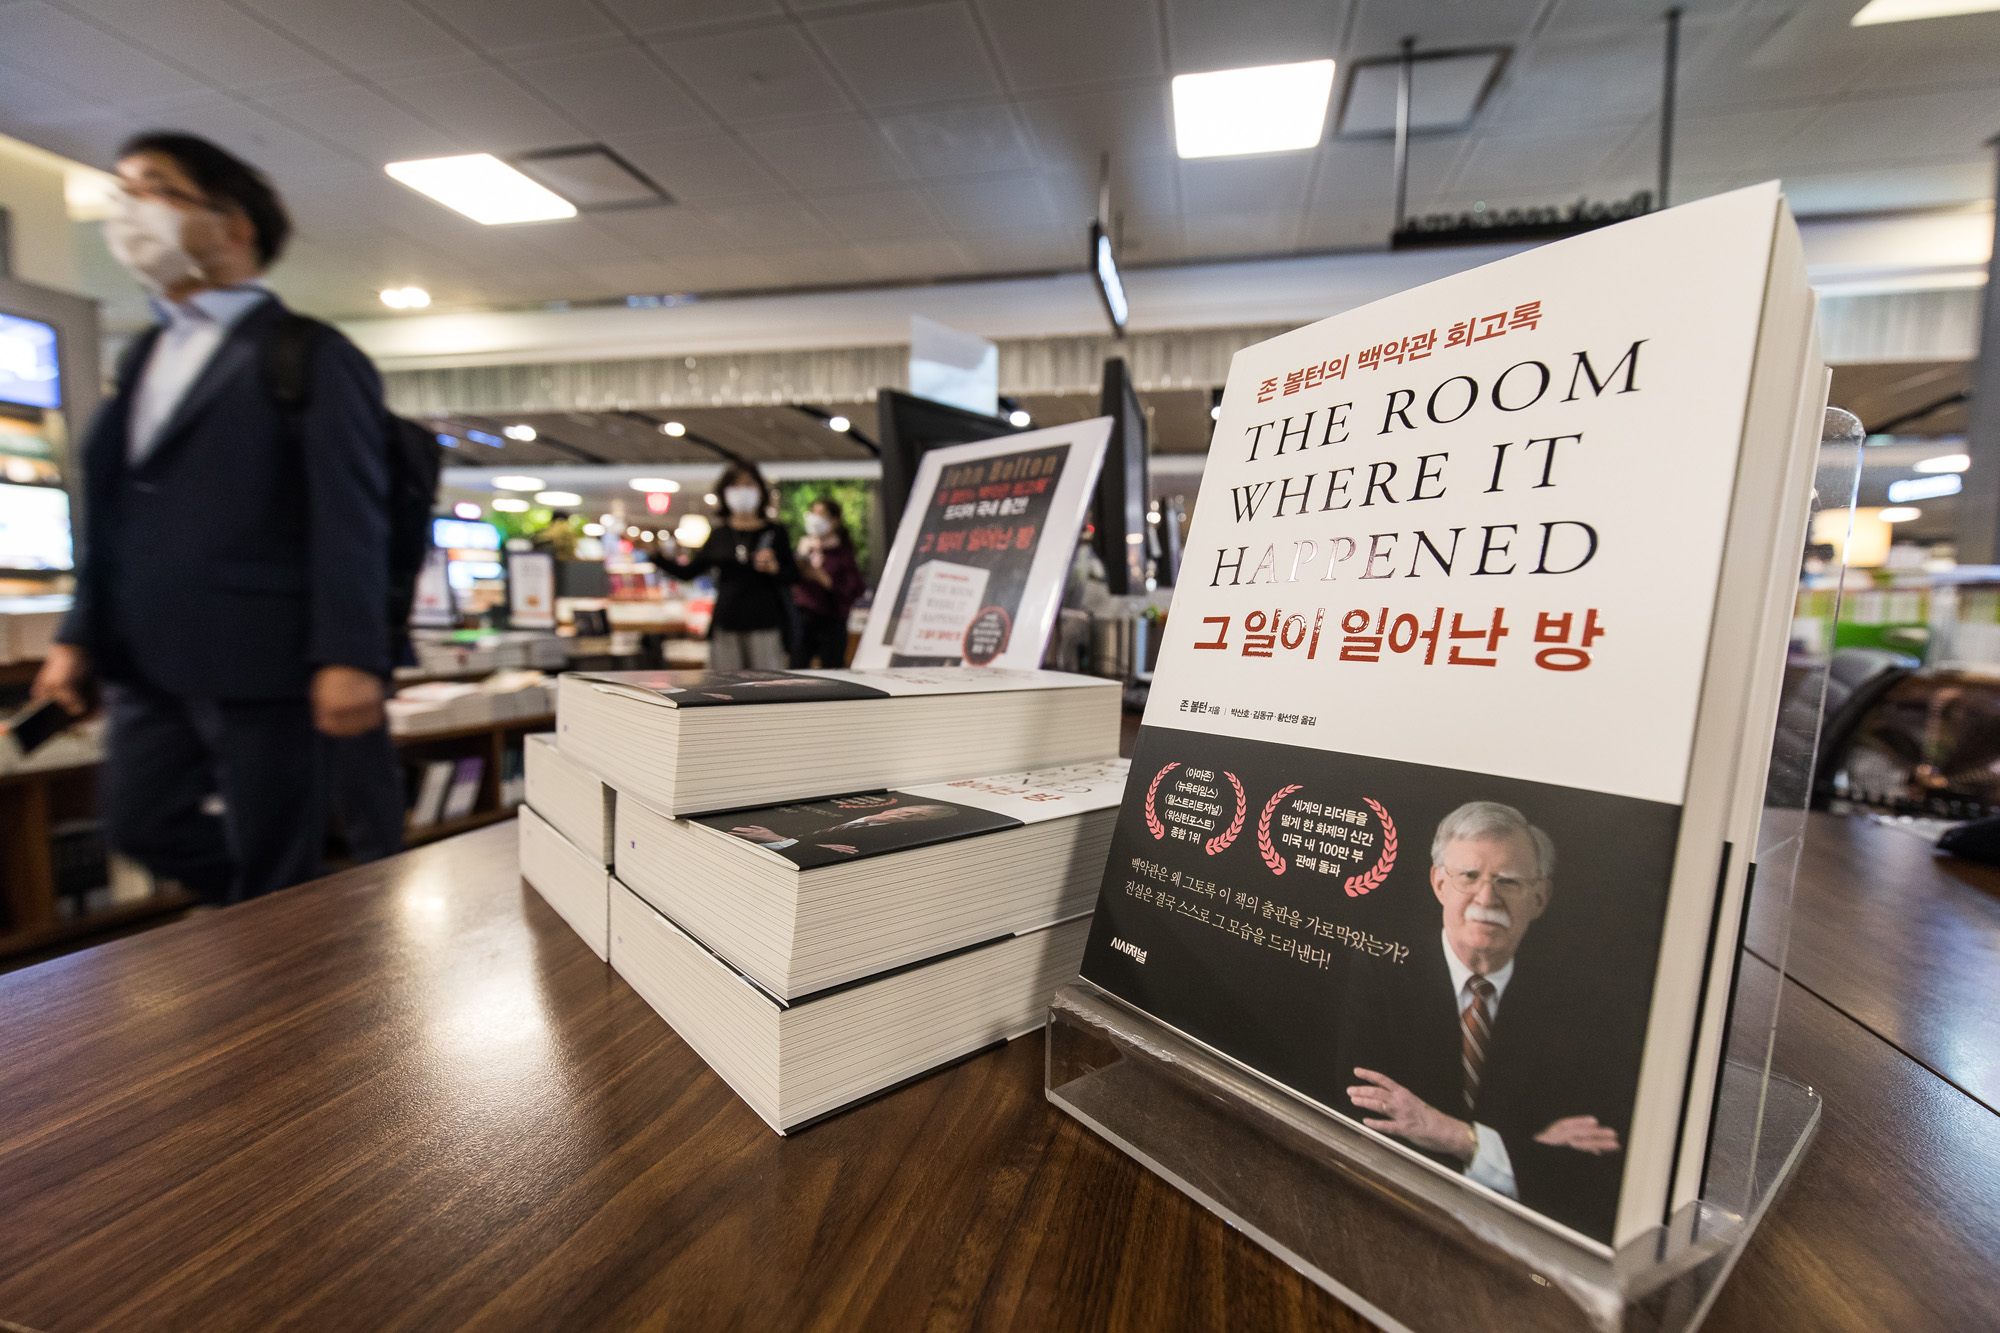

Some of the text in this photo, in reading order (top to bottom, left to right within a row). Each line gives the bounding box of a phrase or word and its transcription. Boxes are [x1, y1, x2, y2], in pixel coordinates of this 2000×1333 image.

[1257, 300, 1543, 403] 존 볼턴의 백악관 회고록
[1244, 338, 1652, 462] THE ROOM
[1231, 432, 1584, 524] WHERE IT
[1209, 520, 1600, 588] HAPPENED
[1193, 606, 1607, 672] 그 일이 일어난 방
[1180, 699, 1189, 712] 존
[1190, 700, 1208, 714] 볼턴
[1208, 706, 1221, 715] 지음
[1300, 715, 1317, 726] 옮김
[1170, 826, 1201, 844] 종합 1위
[1281, 814, 1374, 847] 떨게 한 화제의 신간
[1292, 800, 1368, 827] 세계의 리더들을
[1282, 833, 1364, 863] 미국 내 100만 부
[1296, 854, 1341, 877] 판매 돌파
[1125, 880, 1331, 970] 진실은 결국 스스로 그 모습을 드러낸다!
[1131, 857, 1410, 964] 백악관은 왜 그토록 이 책의 출판을 가로막았는가?
[1110, 936, 1148, 965] 시사저널
